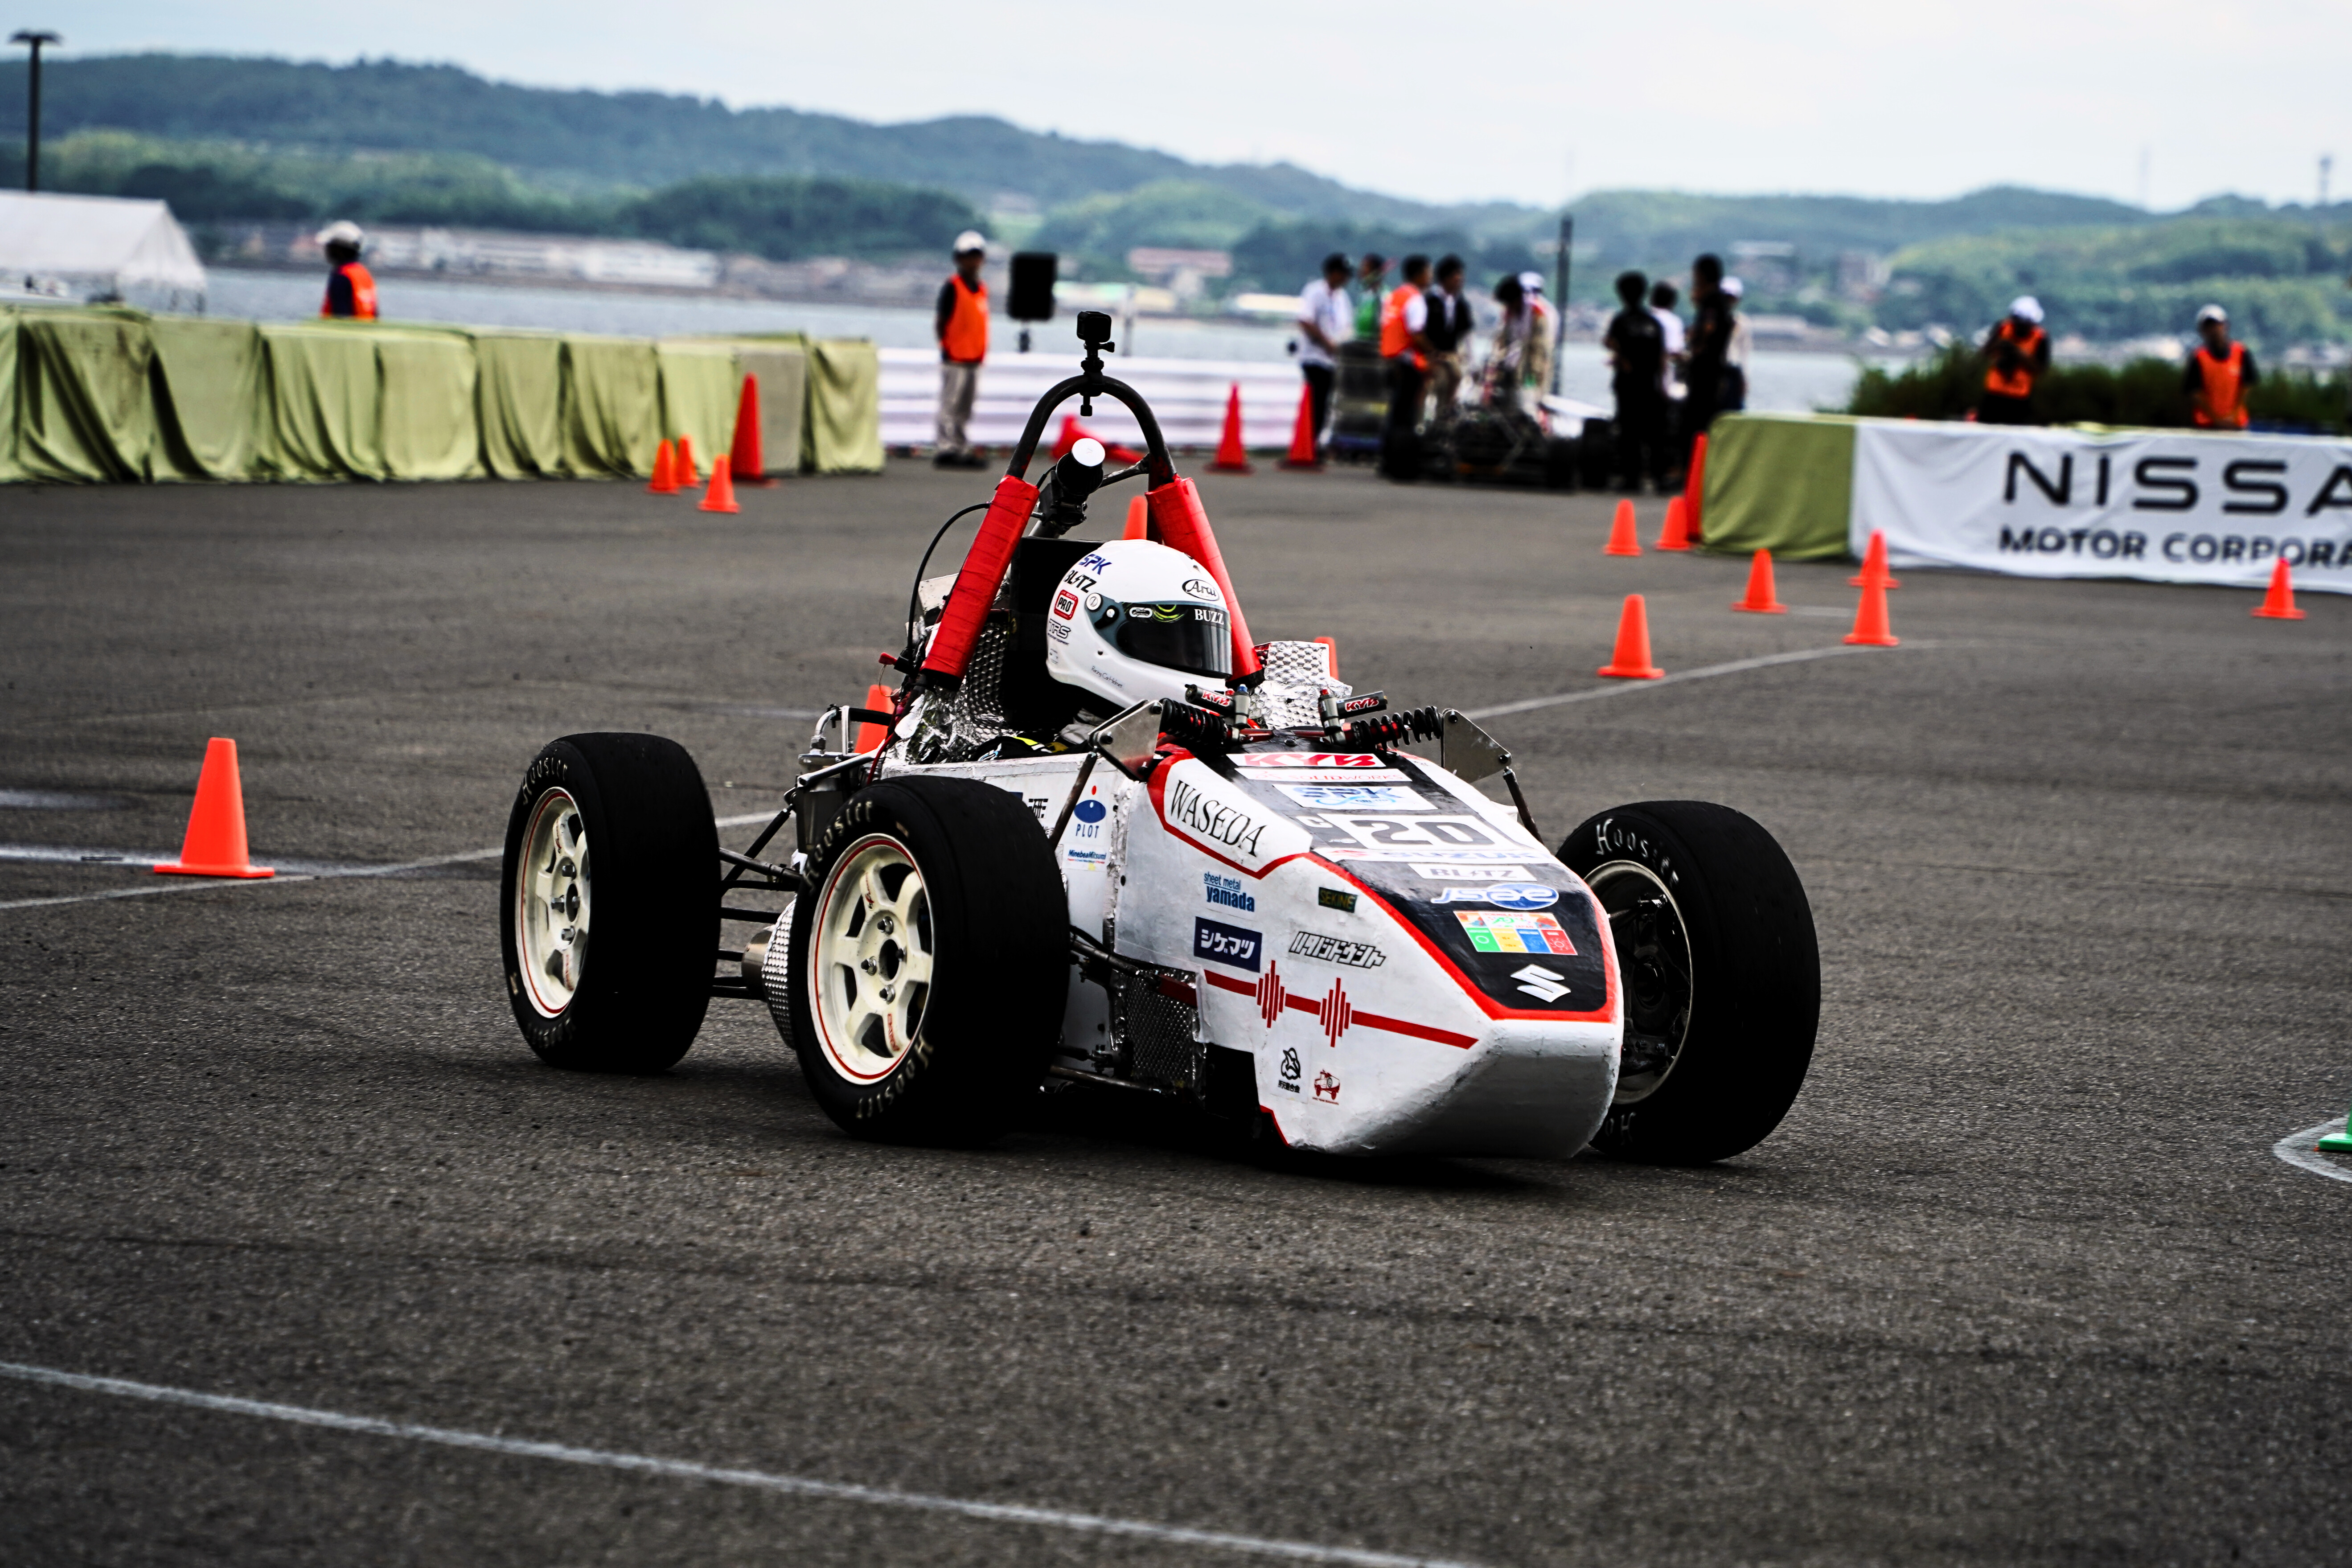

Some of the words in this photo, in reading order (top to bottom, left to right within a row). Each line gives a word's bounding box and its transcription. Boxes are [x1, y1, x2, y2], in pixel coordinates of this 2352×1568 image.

[2004, 451, 2352, 516] NISSA
[1999, 526, 2147, 561] MOTOR
[1078, 554, 1112, 575] SPK
[1063, 570, 1097, 593] BLITZ
[1186, 581, 1217, 597] Arai
[1057, 597, 1072, 612] PRO
[1194, 608, 1225, 625] BUZZ
[1049, 618, 1071, 639] TRS
[1202, 690, 1230, 706] KYB
[1345, 698, 1379, 712] KYB
[1244, 754, 1376, 767] KYB
[1293, 788, 1405, 799] SPK
[1171, 780, 1267, 858] WASEDA
[1075, 823, 1099, 838] PLOT
[1350, 820, 1495, 846] 20
[1204, 871, 1221, 886] sheet
[1223, 878, 1241, 891] metal
[1430, 868, 1517, 878] BLITZ
[1206, 885, 1255, 913] yamada
[1320, 890, 1357, 911] SEKINE
